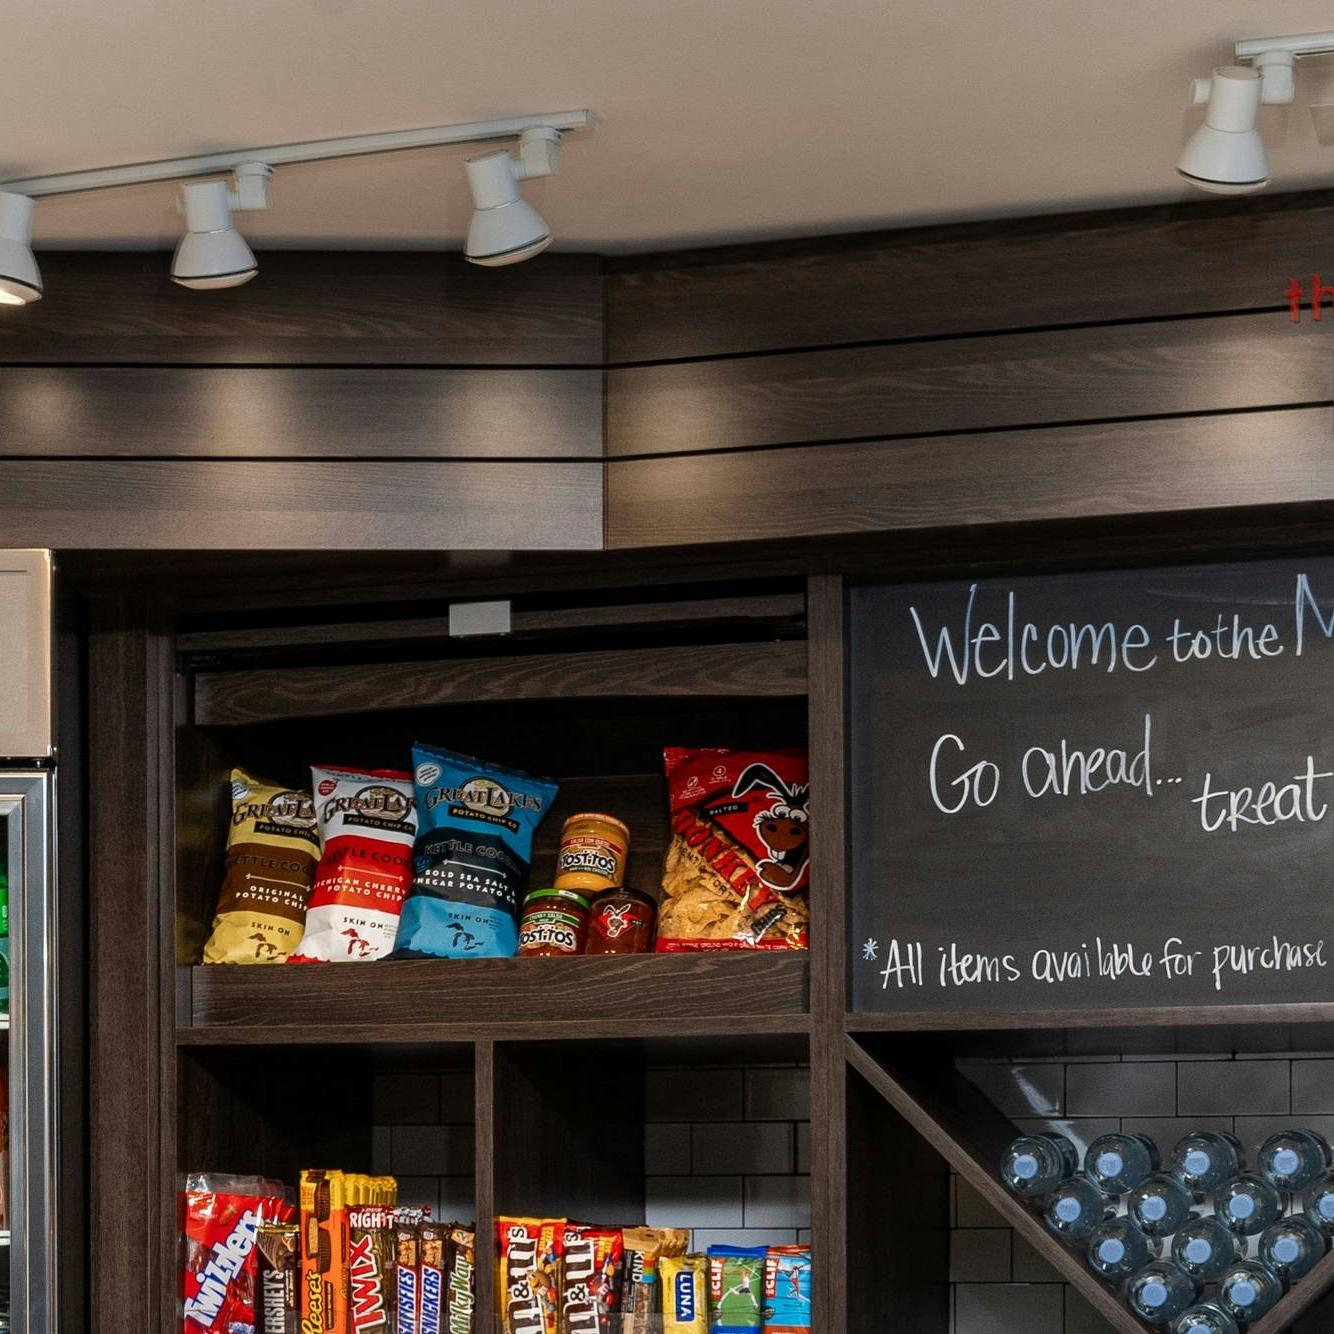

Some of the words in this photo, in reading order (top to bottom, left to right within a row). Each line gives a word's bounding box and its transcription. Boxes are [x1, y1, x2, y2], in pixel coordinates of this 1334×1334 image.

[910, 584, 1158, 686] Welcome
[930, 734, 1000, 815] Go
[1192, 755, 1334, 833] treat
[452, 808, 485, 819] POTATO
[487, 816, 506, 825] CHIP
[709, 804, 739, 815] SALTED
[250, 884, 304, 902] ORIGINAL
[251, 921, 275, 931] SKIN
[278, 927, 291, 936] ON
[939, 943, 1021, 988] items
[1031, 934, 1153, 985] available
[1158, 937, 1202, 977] for
[1212, 936, 1328, 991] purchase
[633, 1250, 643, 1283] KIND
[711, 1258, 724, 1291] CLIF
[680, 1274, 693, 1318] LUNA
